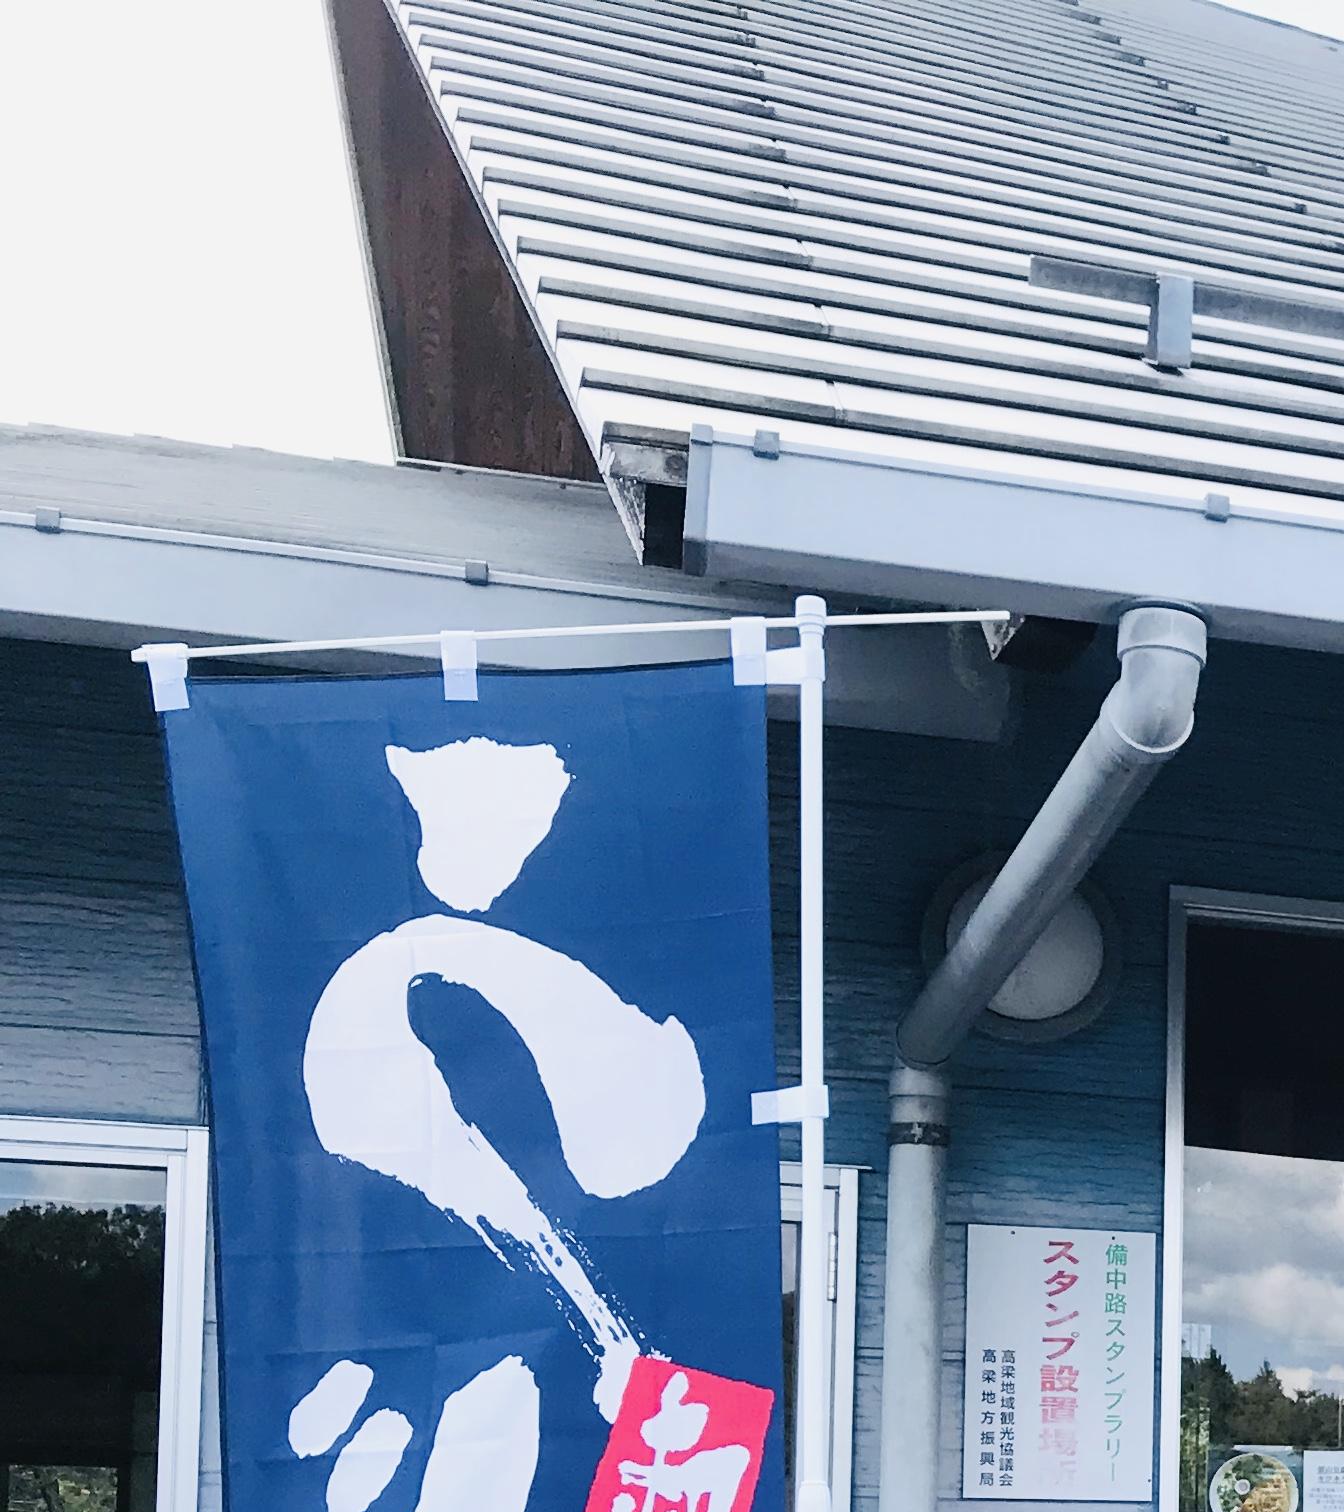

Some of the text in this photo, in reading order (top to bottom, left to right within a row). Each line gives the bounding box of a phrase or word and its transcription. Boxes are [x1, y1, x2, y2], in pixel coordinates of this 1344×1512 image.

[979, 1348, 997, 1487] 高梁地方振興局
[999, 1349, 1016, 1487] 高梁地域観光協議会
